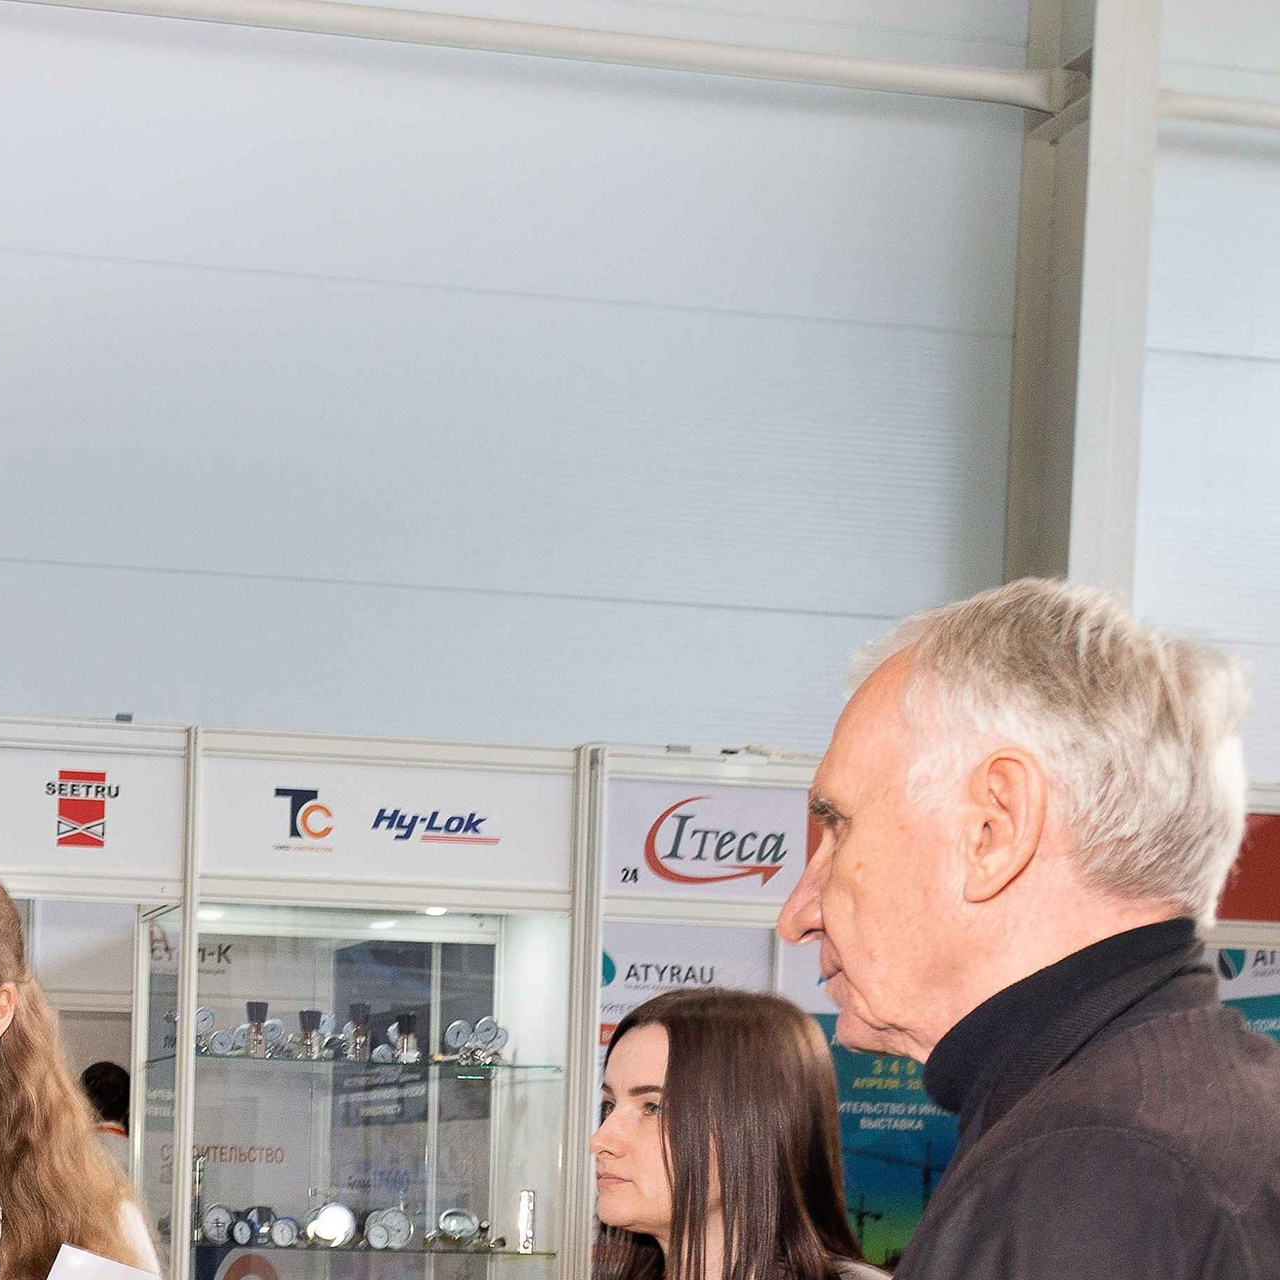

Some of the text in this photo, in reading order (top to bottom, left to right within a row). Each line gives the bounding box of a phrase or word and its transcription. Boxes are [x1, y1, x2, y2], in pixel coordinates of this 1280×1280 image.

[45, 781, 120, 799] SEETRU
[371, 808, 487, 841] Hy-Lok
[620, 867, 639, 883] 24
[624, 963, 714, 985] ATYRAU
